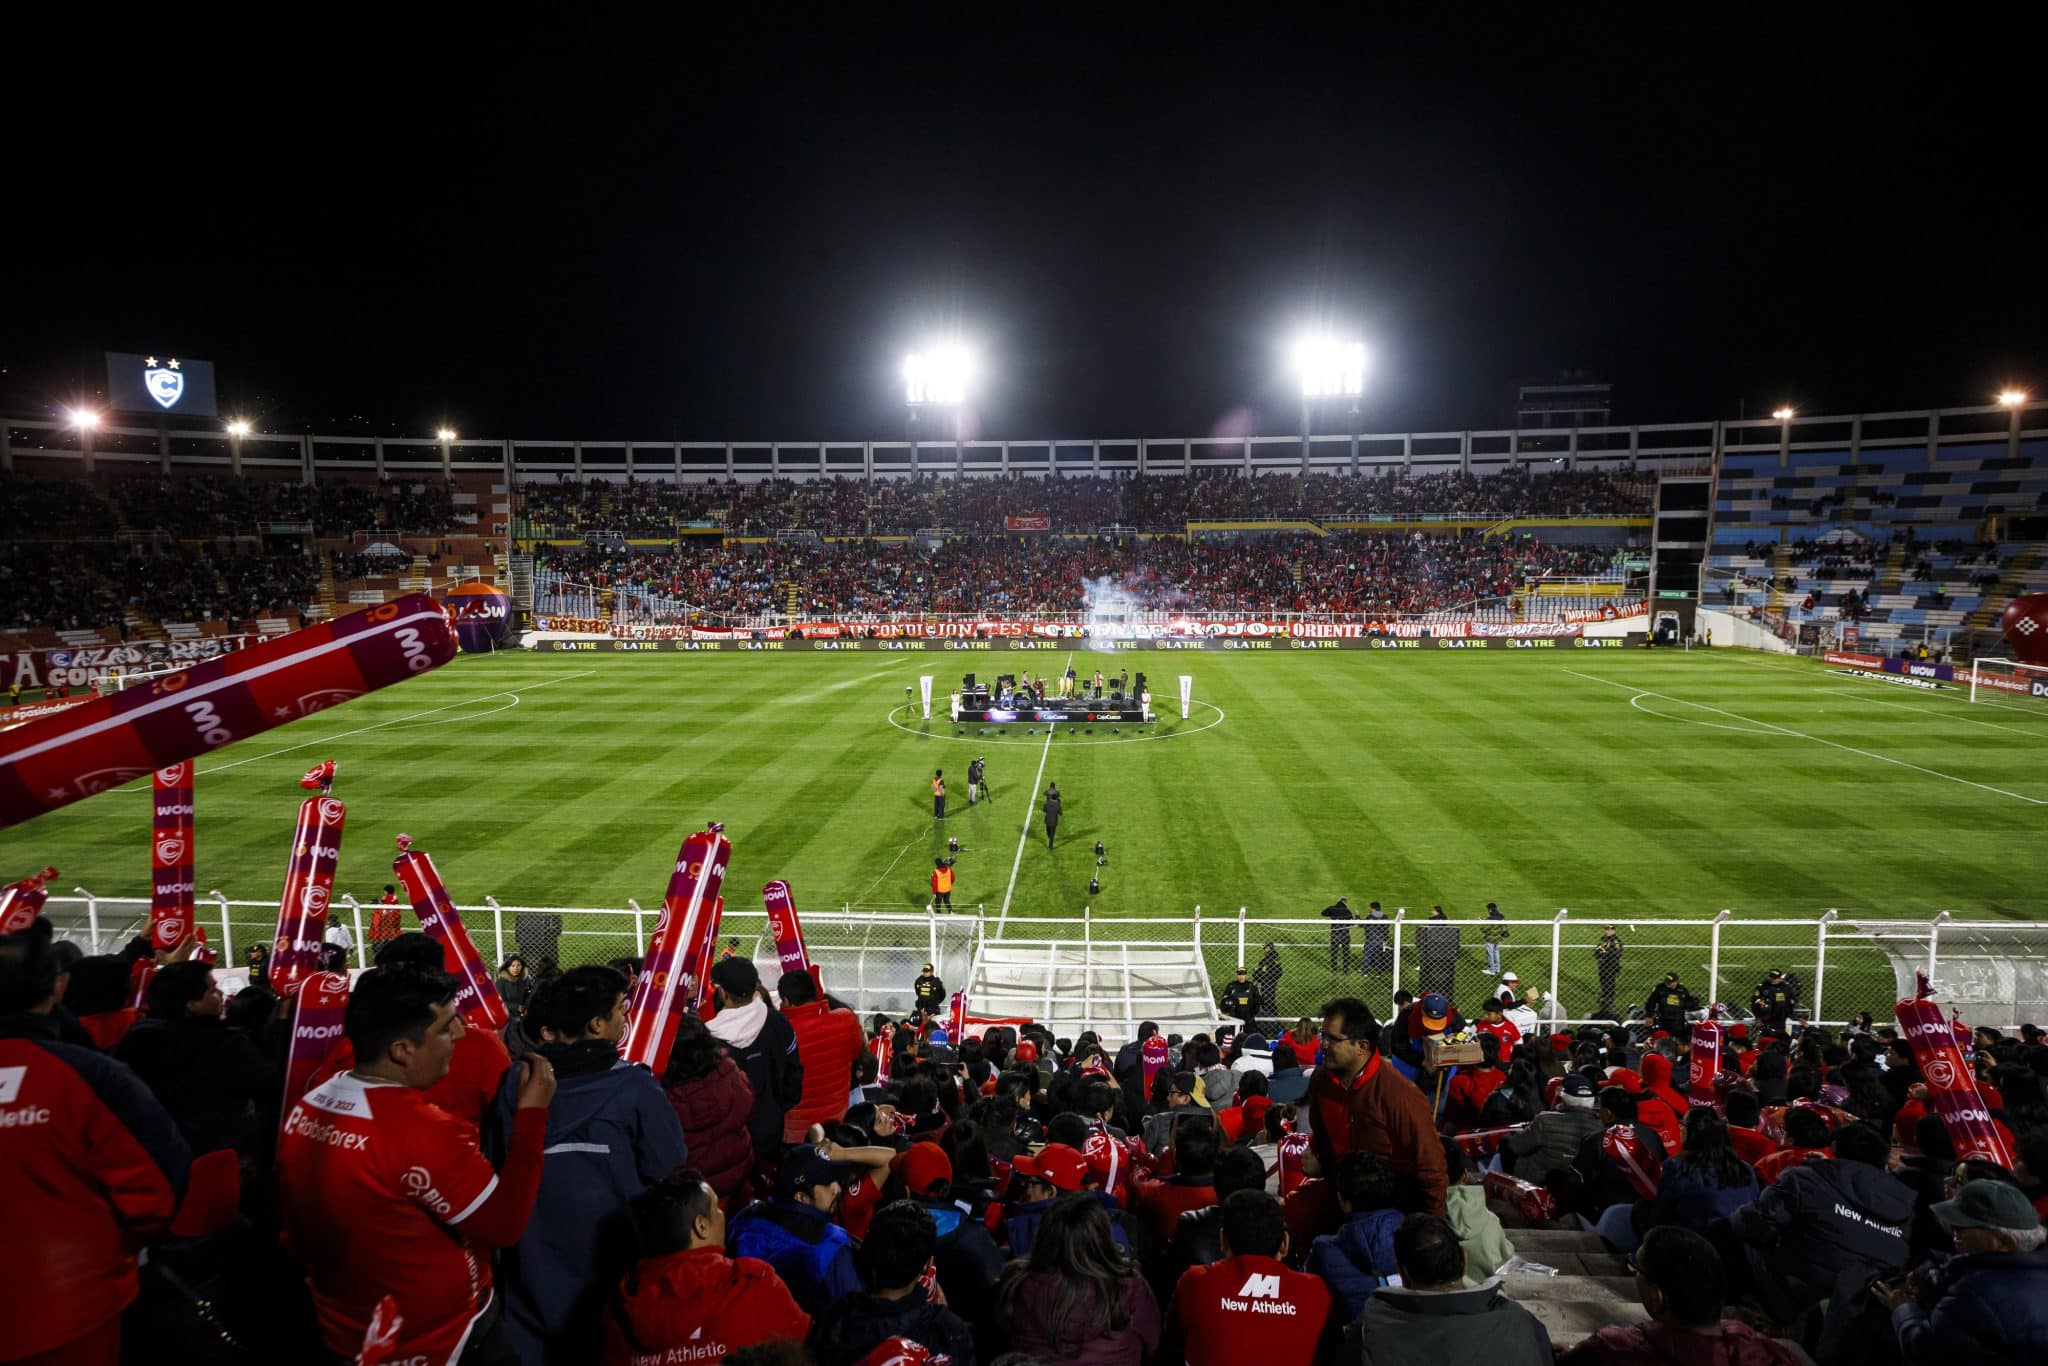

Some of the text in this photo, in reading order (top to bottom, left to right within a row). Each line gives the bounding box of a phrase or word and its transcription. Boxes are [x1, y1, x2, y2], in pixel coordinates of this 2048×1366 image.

[1293, 623, 1363, 638] ORIENTE
[1386, 623, 1467, 638] INCONCIONAL
[1910, 665, 1936, 678] WOW
[1908, 1022, 1949, 1037] WOW
[1944, 1109, 1989, 1124] WOW
[422, 1187, 452, 1214] BIO
[1834, 1203, 1862, 1222] New
[1221, 1297, 1296, 1316] New Athletic
[666, 1340, 727, 1366] Athletic
